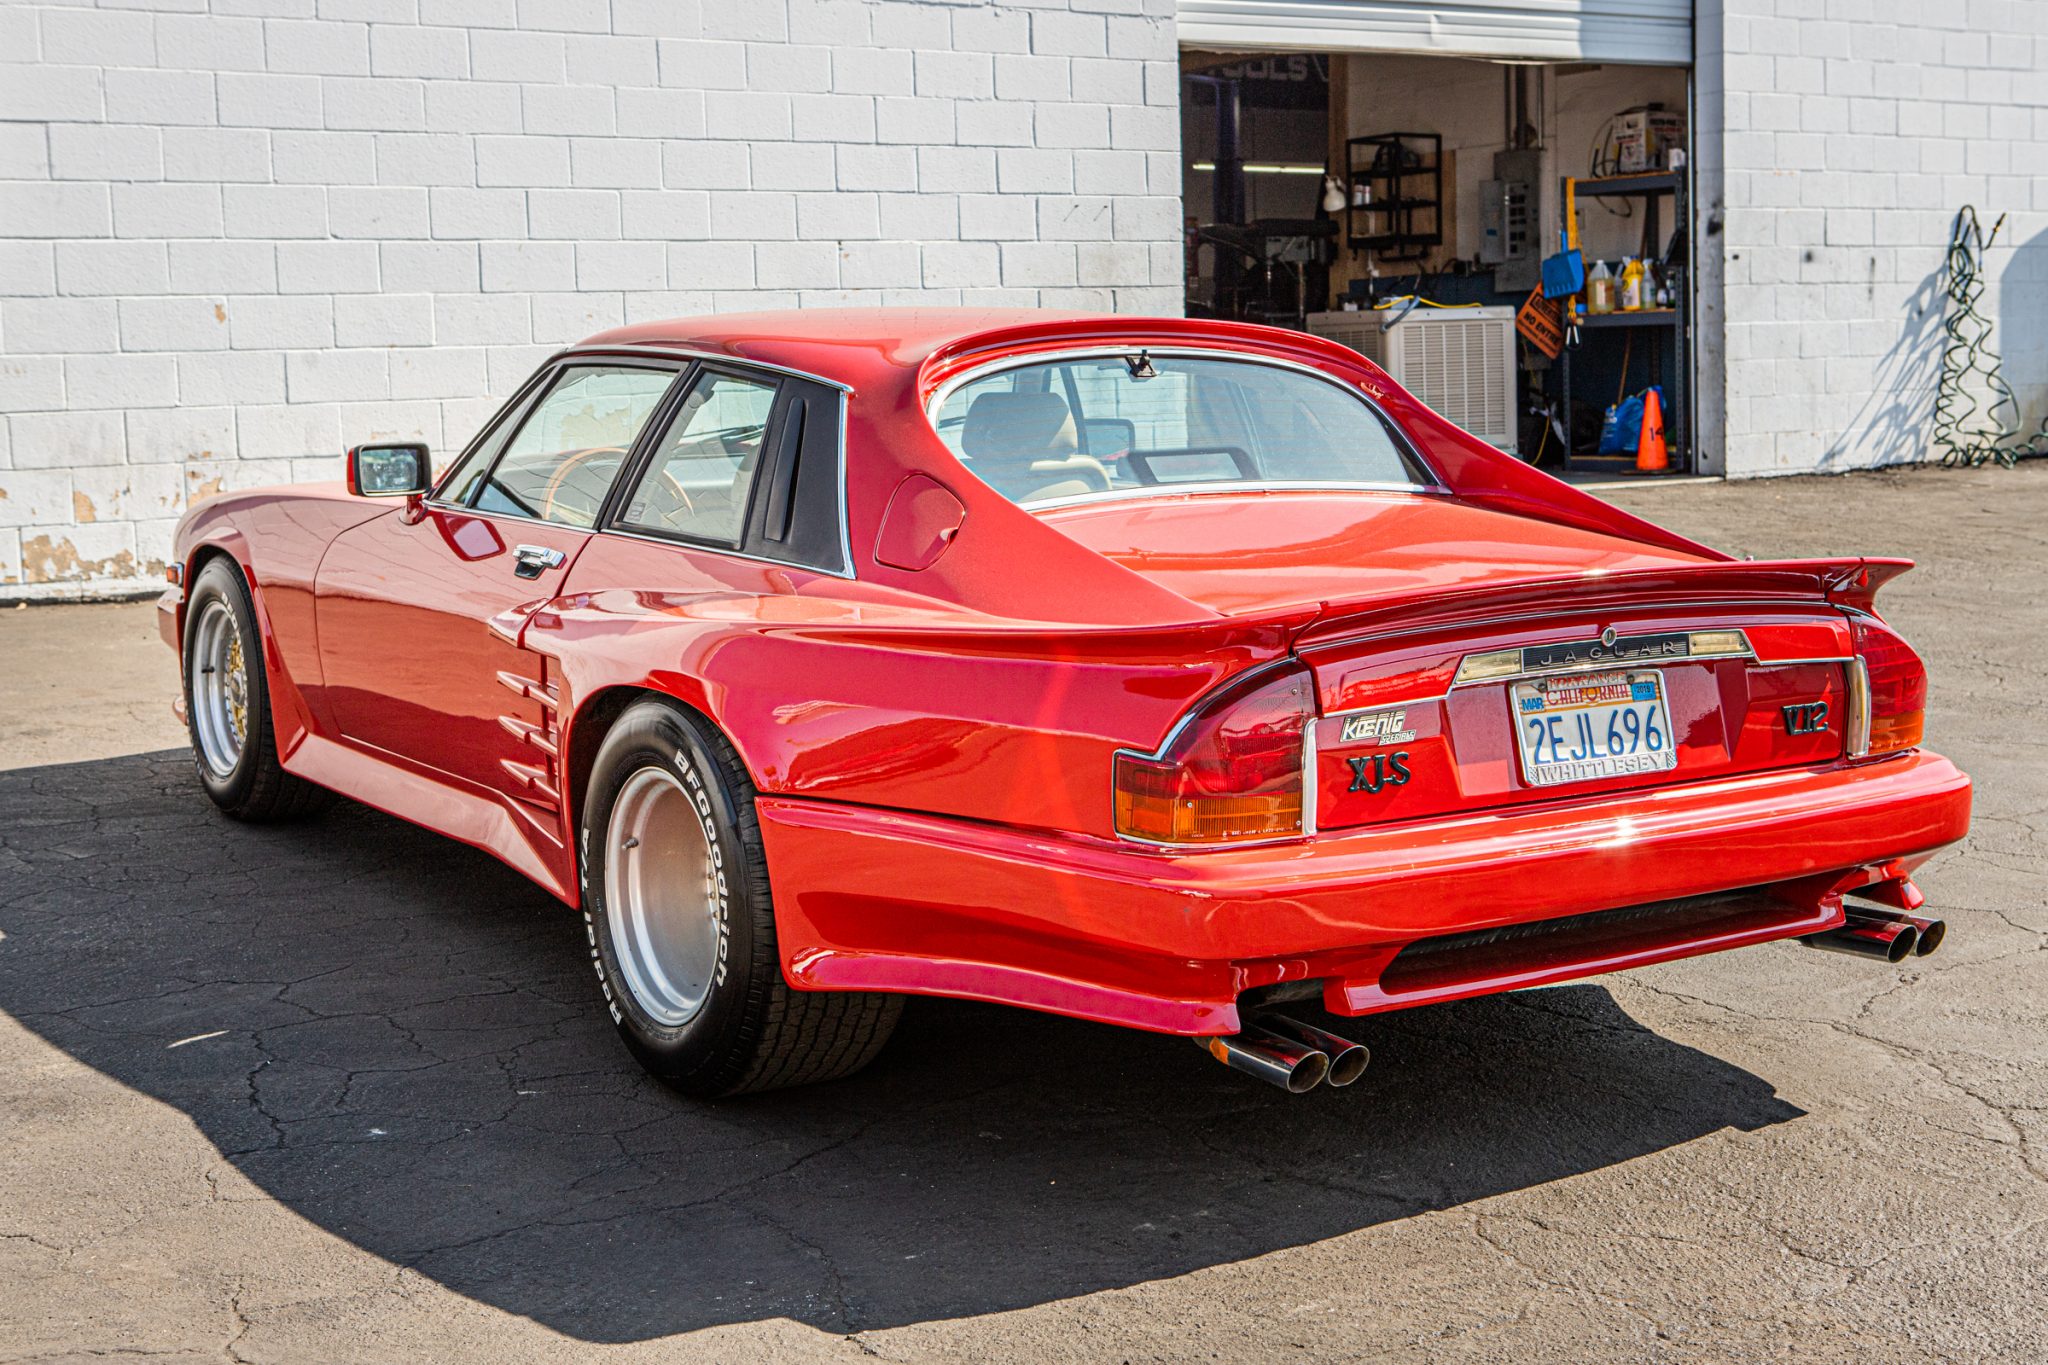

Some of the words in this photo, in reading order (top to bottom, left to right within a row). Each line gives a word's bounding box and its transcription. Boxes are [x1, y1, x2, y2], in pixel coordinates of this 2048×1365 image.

[1207, 55, 1309, 81] OOLS
[1540, 641, 1677, 665] JAGUAR
[1548, 672, 1627, 689] TORRANCE
[1521, 697, 1545, 712] MAR
[1546, 684, 1629, 706] CALIFORNIA
[1781, 701, 1829, 736] V12
[1529, 705, 1663, 765] 2EJL696
[1540, 753, 1662, 783] WHITTLESEY
[674, 749, 730, 988] BFGoodrich
